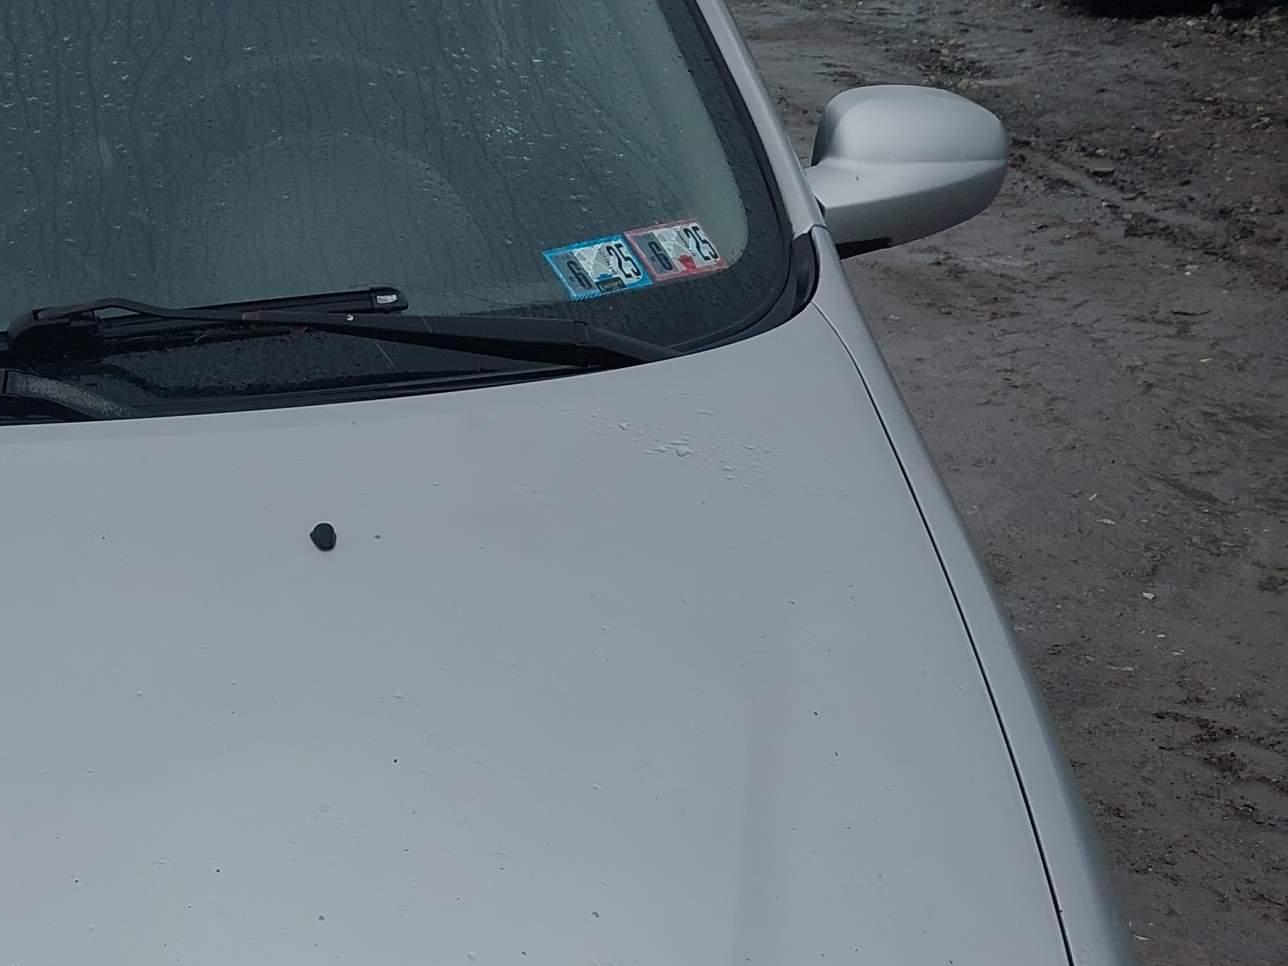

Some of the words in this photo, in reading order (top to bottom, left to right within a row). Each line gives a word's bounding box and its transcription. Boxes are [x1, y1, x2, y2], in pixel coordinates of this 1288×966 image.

[606, 243, 642, 279] 25
[648, 240, 674, 272] 6
[683, 225, 720, 261] 25
